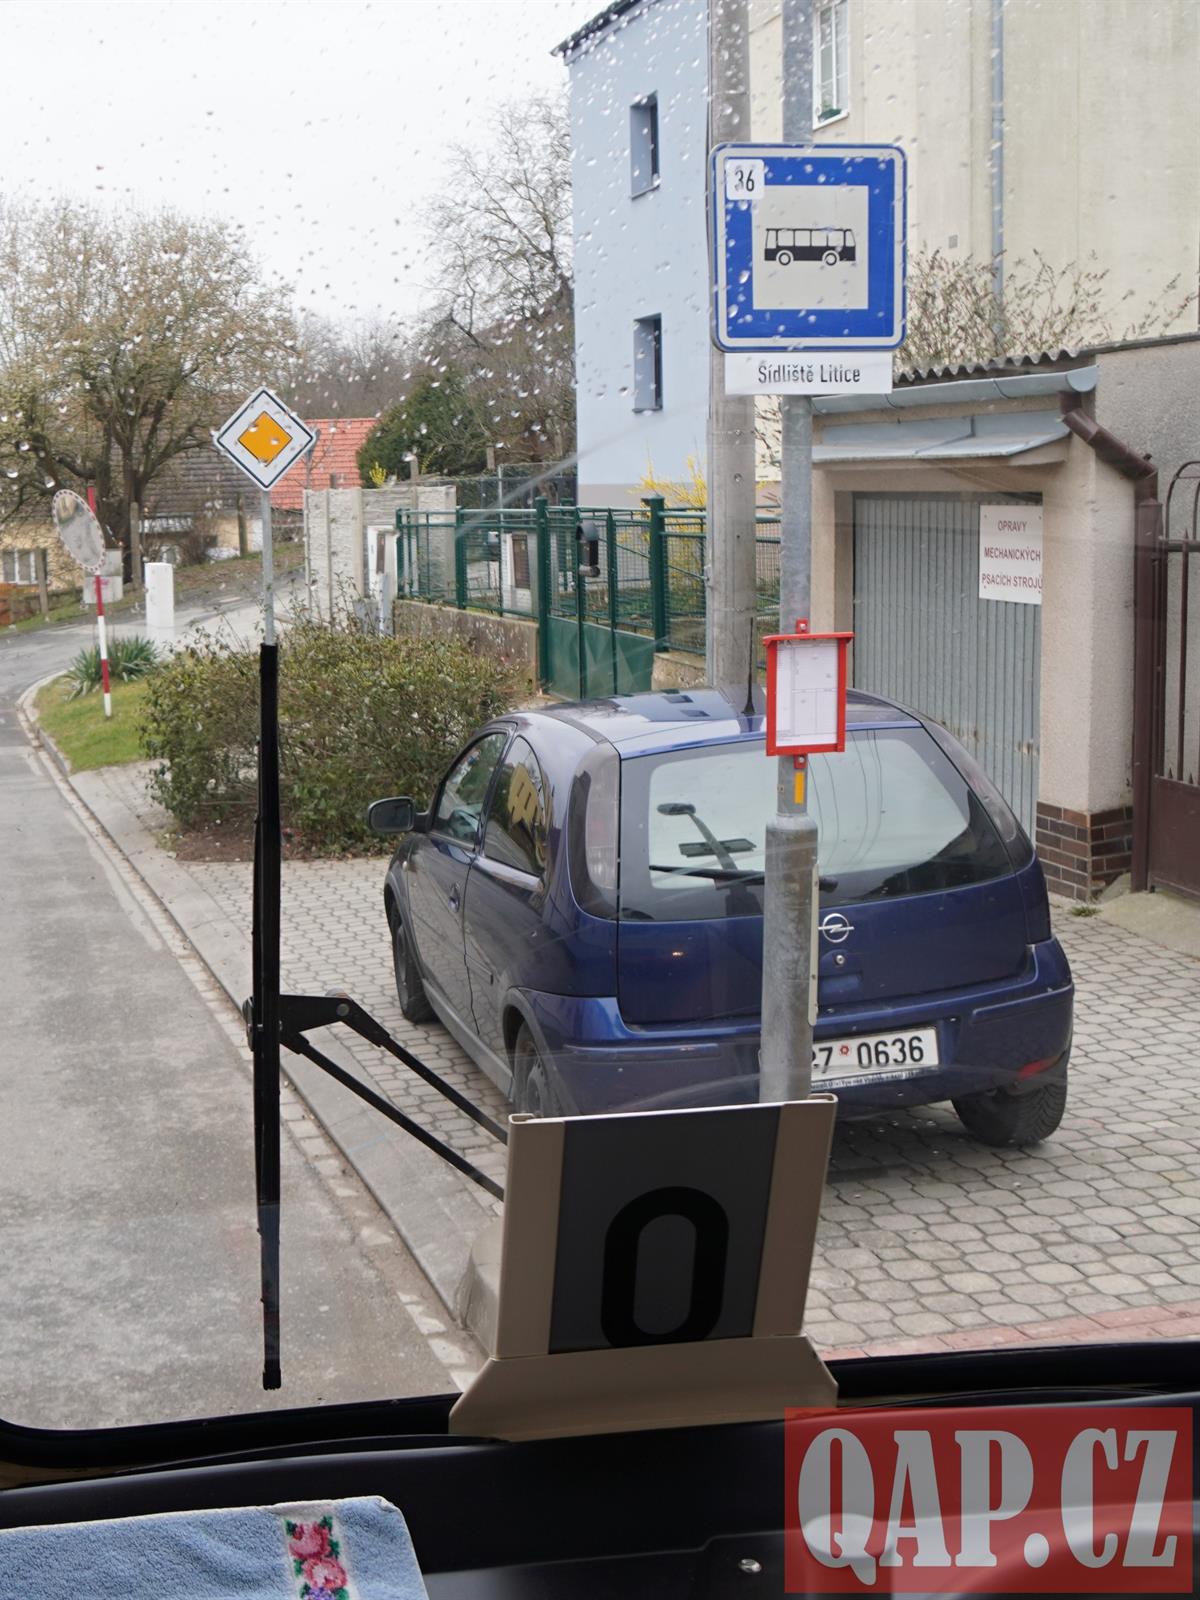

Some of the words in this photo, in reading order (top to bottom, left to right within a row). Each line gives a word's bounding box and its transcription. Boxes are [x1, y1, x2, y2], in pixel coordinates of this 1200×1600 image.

[734, 170, 755, 192] 36
[758, 364, 814, 384] Sídliště
[820, 364, 860, 384] Litice
[997, 520, 1027, 532] OPRAVY
[984, 546, 1041, 561] MECHANICKÝCH
[982, 572, 1011, 586] PSACÍCH
[857, 1036, 924, 1069] 0636
